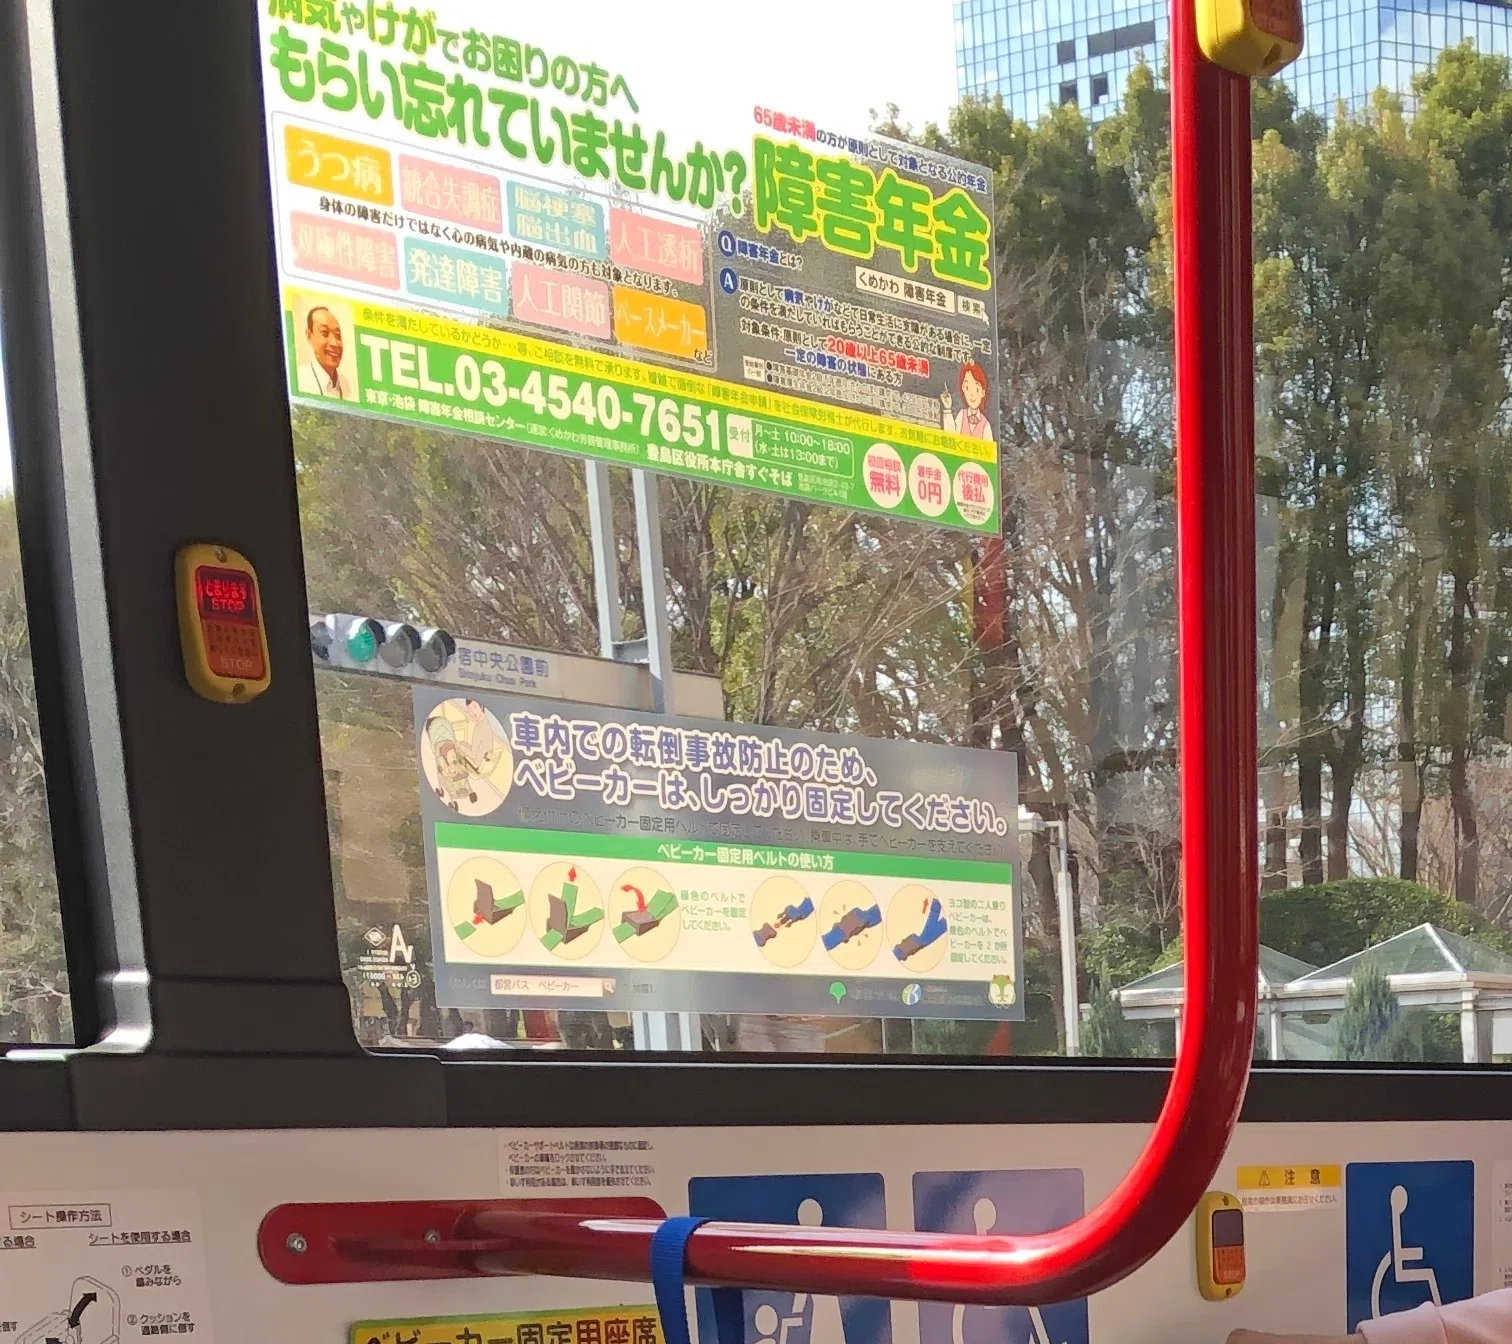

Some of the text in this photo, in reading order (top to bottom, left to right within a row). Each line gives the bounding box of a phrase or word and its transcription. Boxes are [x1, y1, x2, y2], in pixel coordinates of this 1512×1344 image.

[297, 139, 383, 195] うつ病
[754, 136, 990, 289] 障害年金
[616, 220, 699, 274] 人工透析
[409, 247, 503, 302] 発達障害
[904, 281, 947, 309] 障害年金
[516, 273, 606, 328] 人工関節
[693, 348, 713, 364] など
[360, 333, 721, 452] TEL.03-4540-7651
[729, 425, 750, 443] 受付
[870, 471, 900, 497] 無料
[211, 598, 246, 613] STOP
[456, 647, 548, 677] 宿中央公園前
[514, 712, 877, 787] 車内での転倒事故防止のため、
[514, 761, 1007, 836] ベビーカーは、しっかり固定してください。
[657, 843, 835, 871] ベビーカー固定用ベルトの使い方
[20, 1209, 103, 1223] シート操作方法
